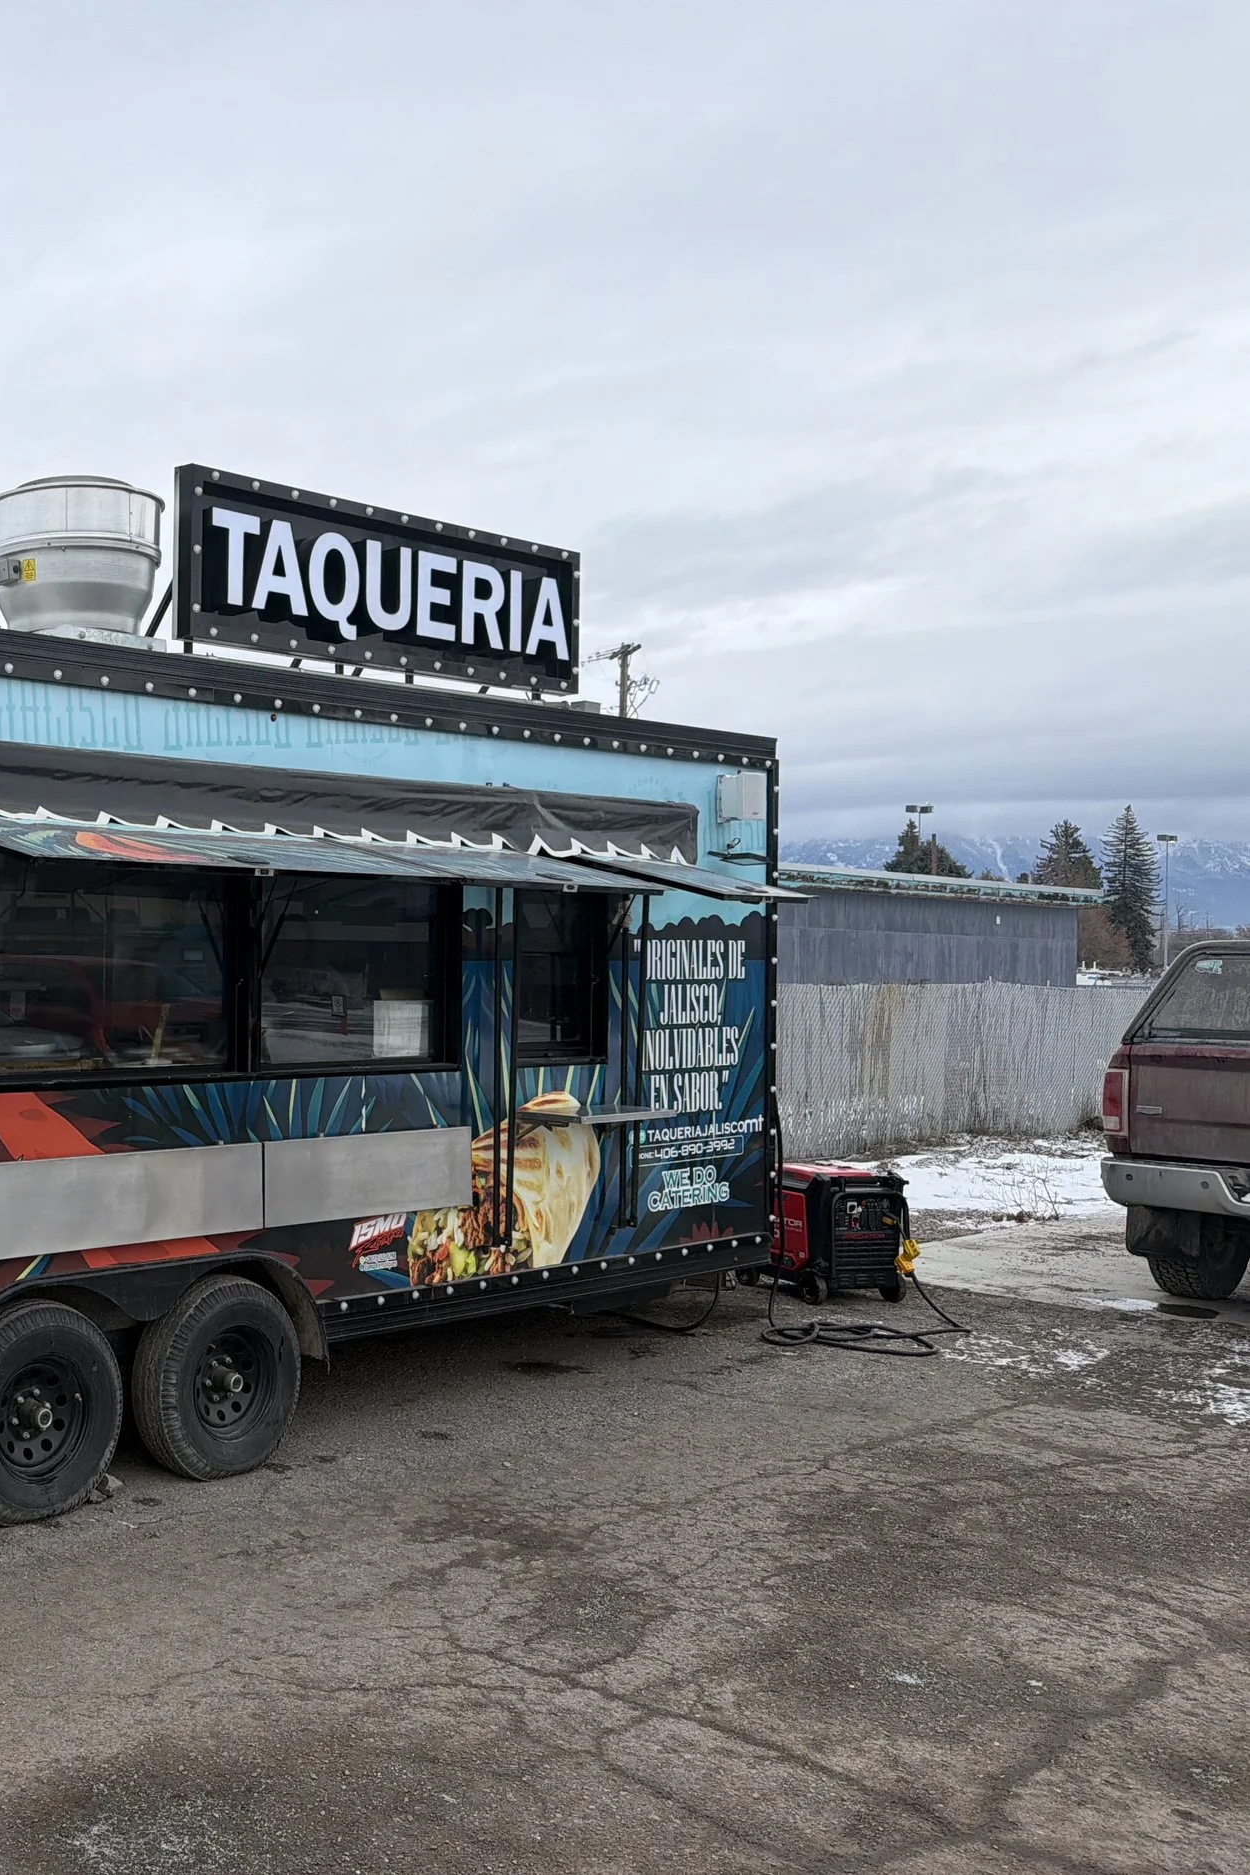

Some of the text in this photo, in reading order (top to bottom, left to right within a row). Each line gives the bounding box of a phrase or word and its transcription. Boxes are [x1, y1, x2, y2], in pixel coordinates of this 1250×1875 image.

[211, 505, 570, 661] TAQUERIA
[728, 940, 745, 980] DE
[659, 983, 722, 1026] JALISCO,
[650, 1074, 670, 1113] EN
[654, 1138, 735, 1160] 406-890-3992
[647, 1181, 730, 1212] CATERING
[662, 1164, 717, 1191] WE DO
